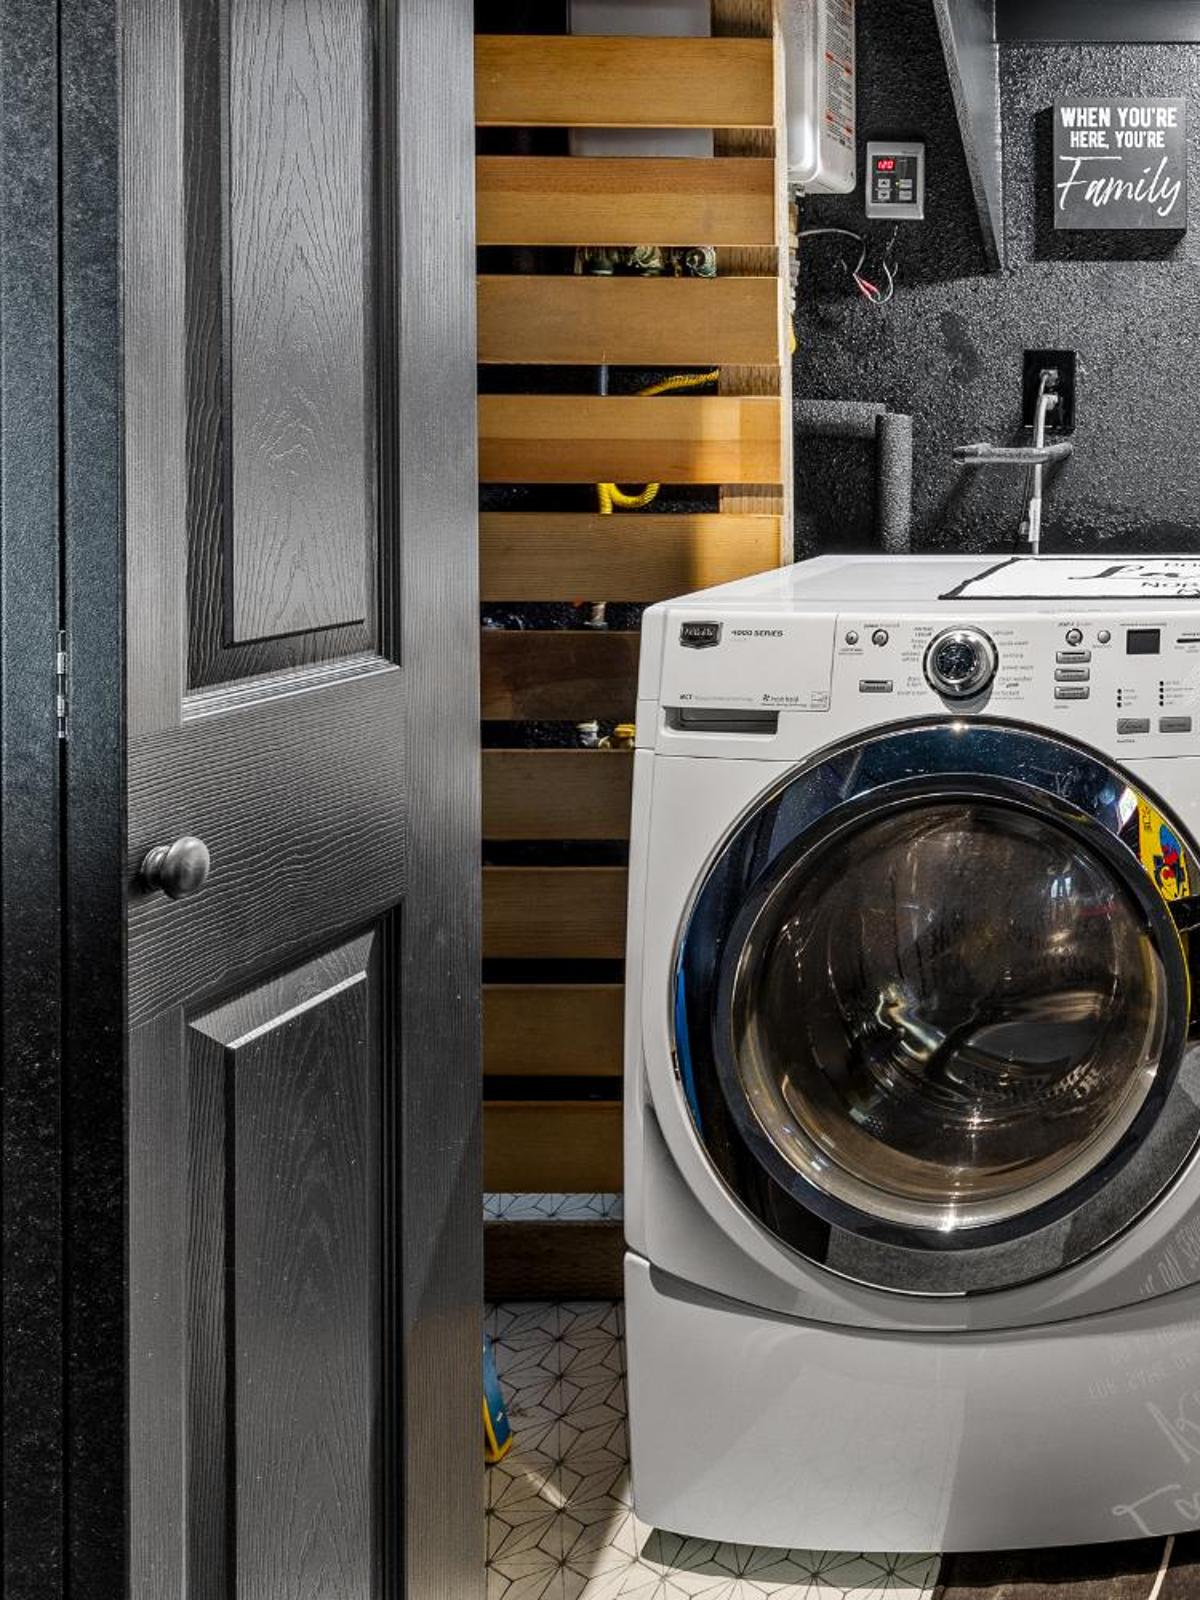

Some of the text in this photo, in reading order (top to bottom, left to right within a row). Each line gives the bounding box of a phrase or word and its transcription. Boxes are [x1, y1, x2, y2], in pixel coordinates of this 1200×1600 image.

[1060, 107, 1177, 127] WHEN YOU'RE
[1070, 131, 1165, 149] HERE, YOU'RE
[1057, 156, 1181, 217] Family
